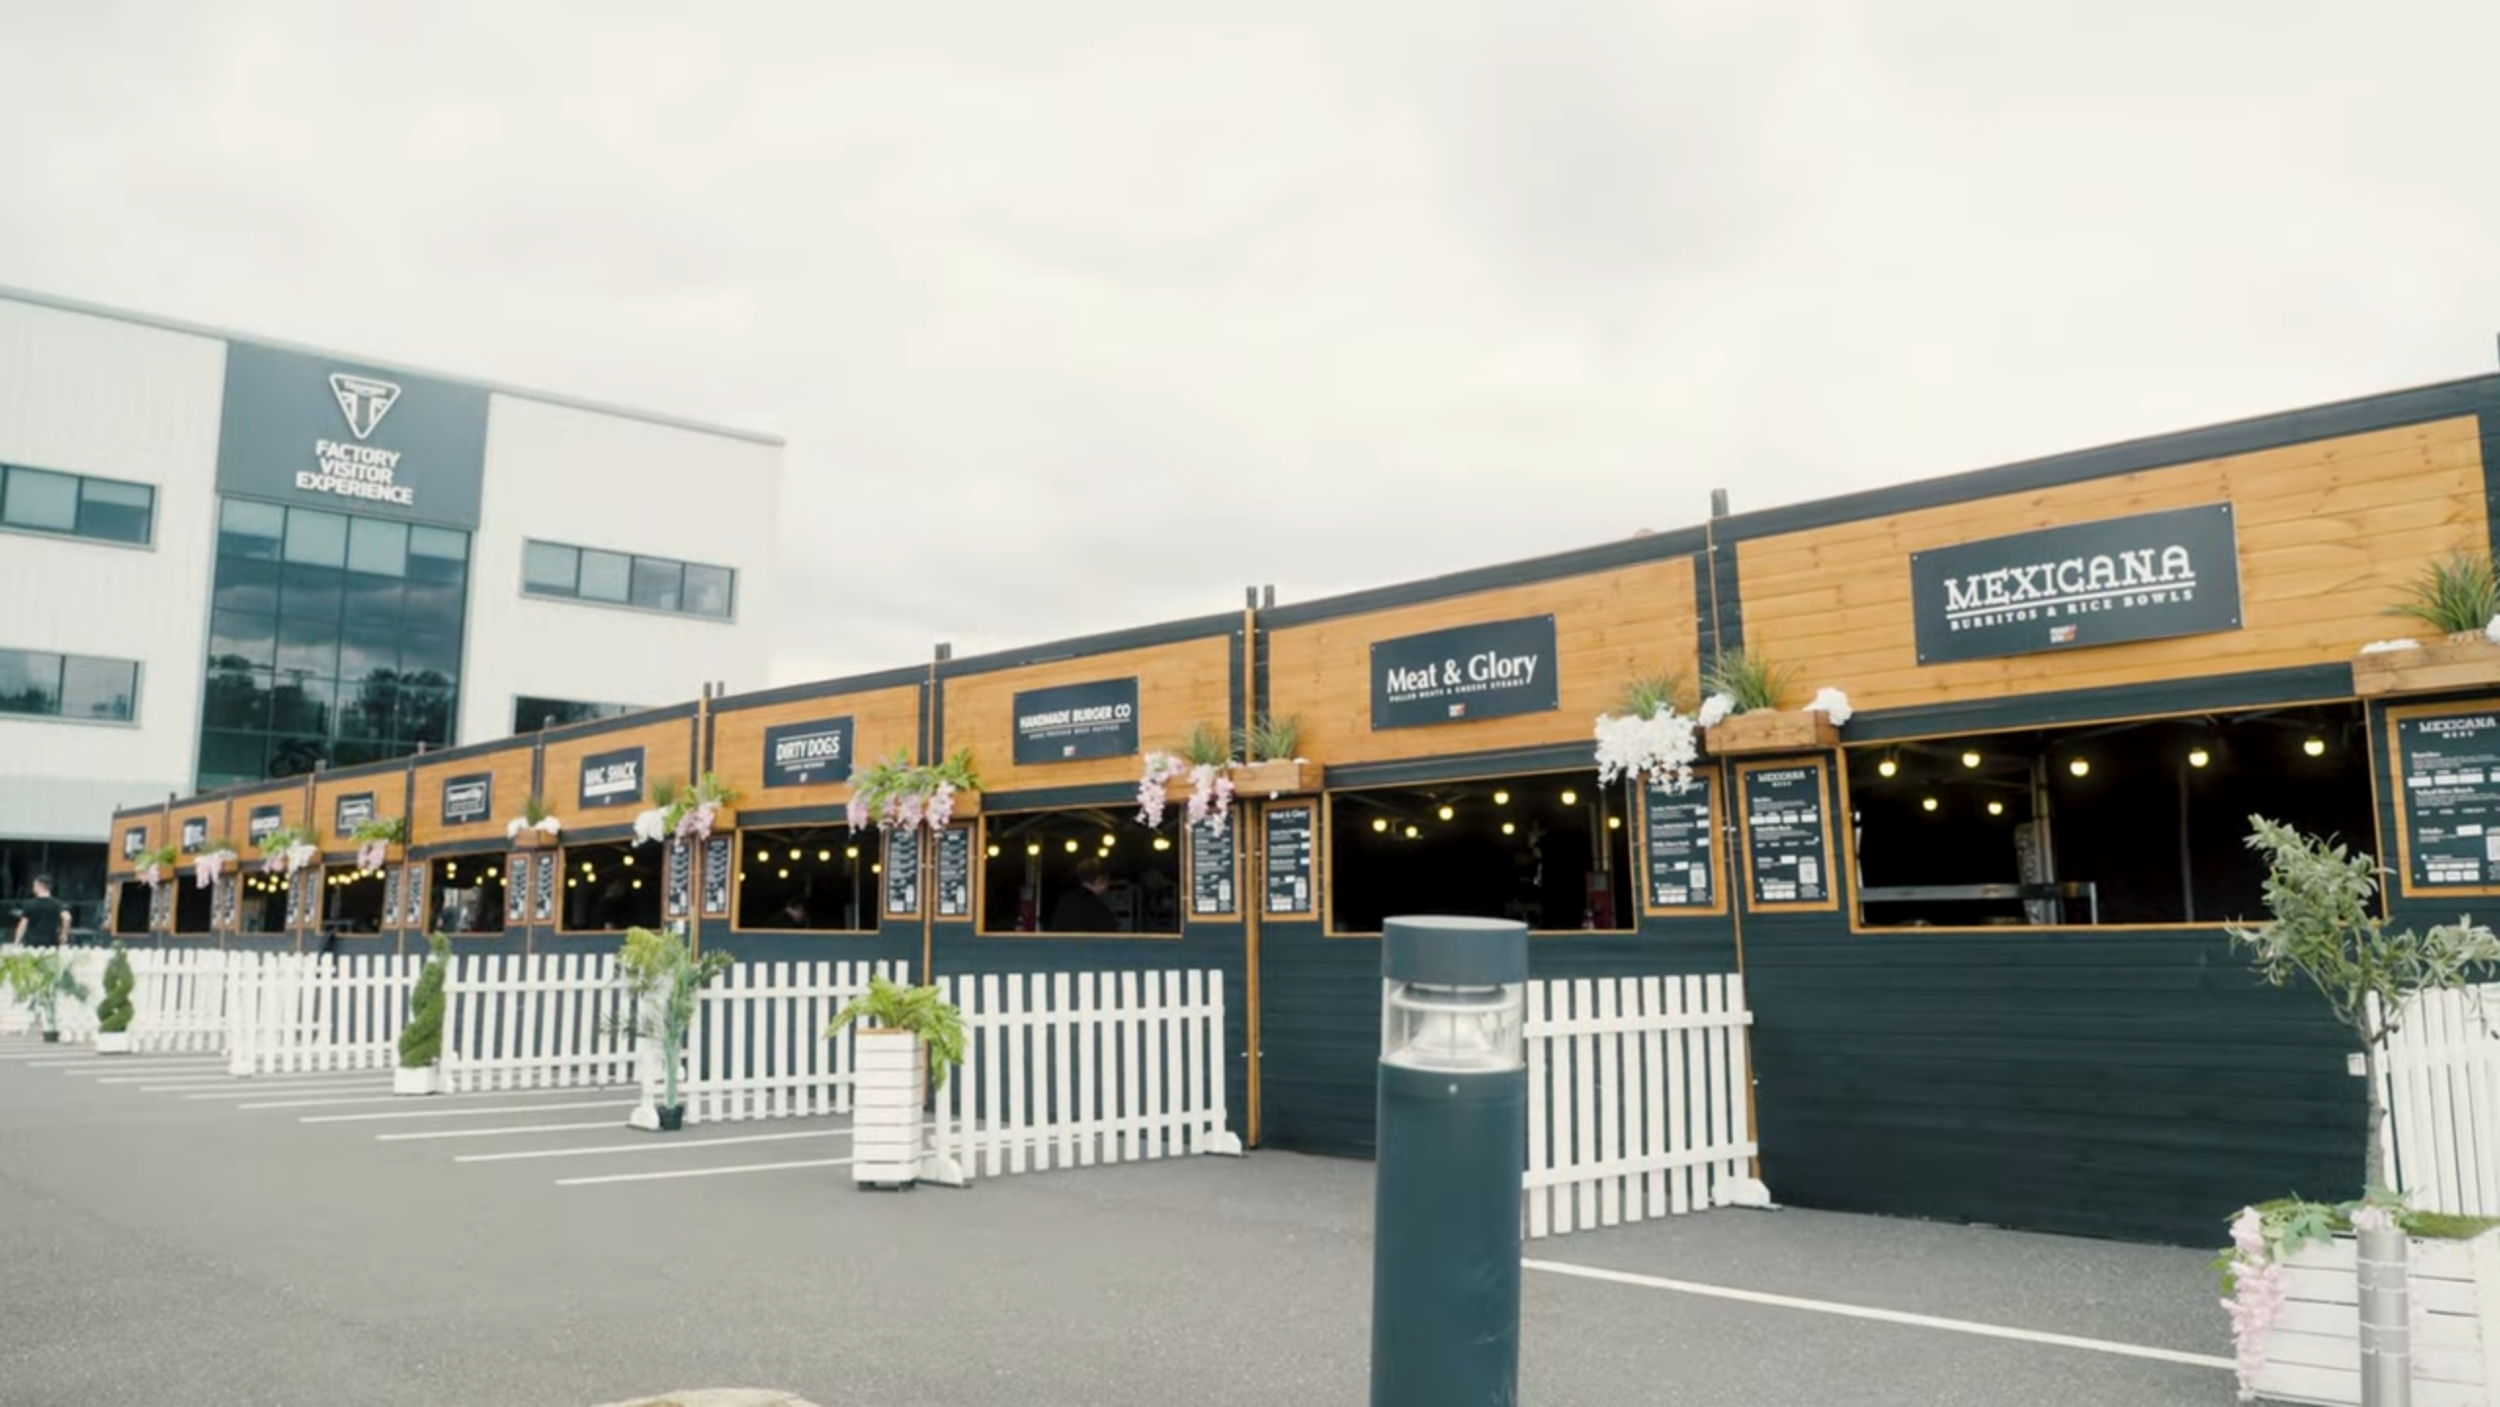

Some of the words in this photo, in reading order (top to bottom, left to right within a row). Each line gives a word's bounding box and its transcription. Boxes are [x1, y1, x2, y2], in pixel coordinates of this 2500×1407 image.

[316, 440, 401, 468] FACTORY
[320, 457, 393, 484] VISITOR
[296, 471, 413, 505] EXPERIENCE
[1944, 545, 2196, 611] MEXICANA
[1950, 608, 2038, 631] BURRITOS
[2046, 606, 2057, 617] &
[2067, 598, 2113, 614] RICE
[2124, 589, 2194, 607] BOWLS
[1387, 663, 1438, 694] Meat
[1443, 659, 1461, 685] &
[1468, 651, 1538, 684] Glory
[1019, 709, 1070, 729] HANDMADE
[1072, 705, 1113, 722] BURGER
[1114, 703, 1131, 718] CO
[2419, 717, 2496, 733] MEXICANA
[777, 740, 808, 761] DIRTY
[808, 736, 840, 757] DOGS
